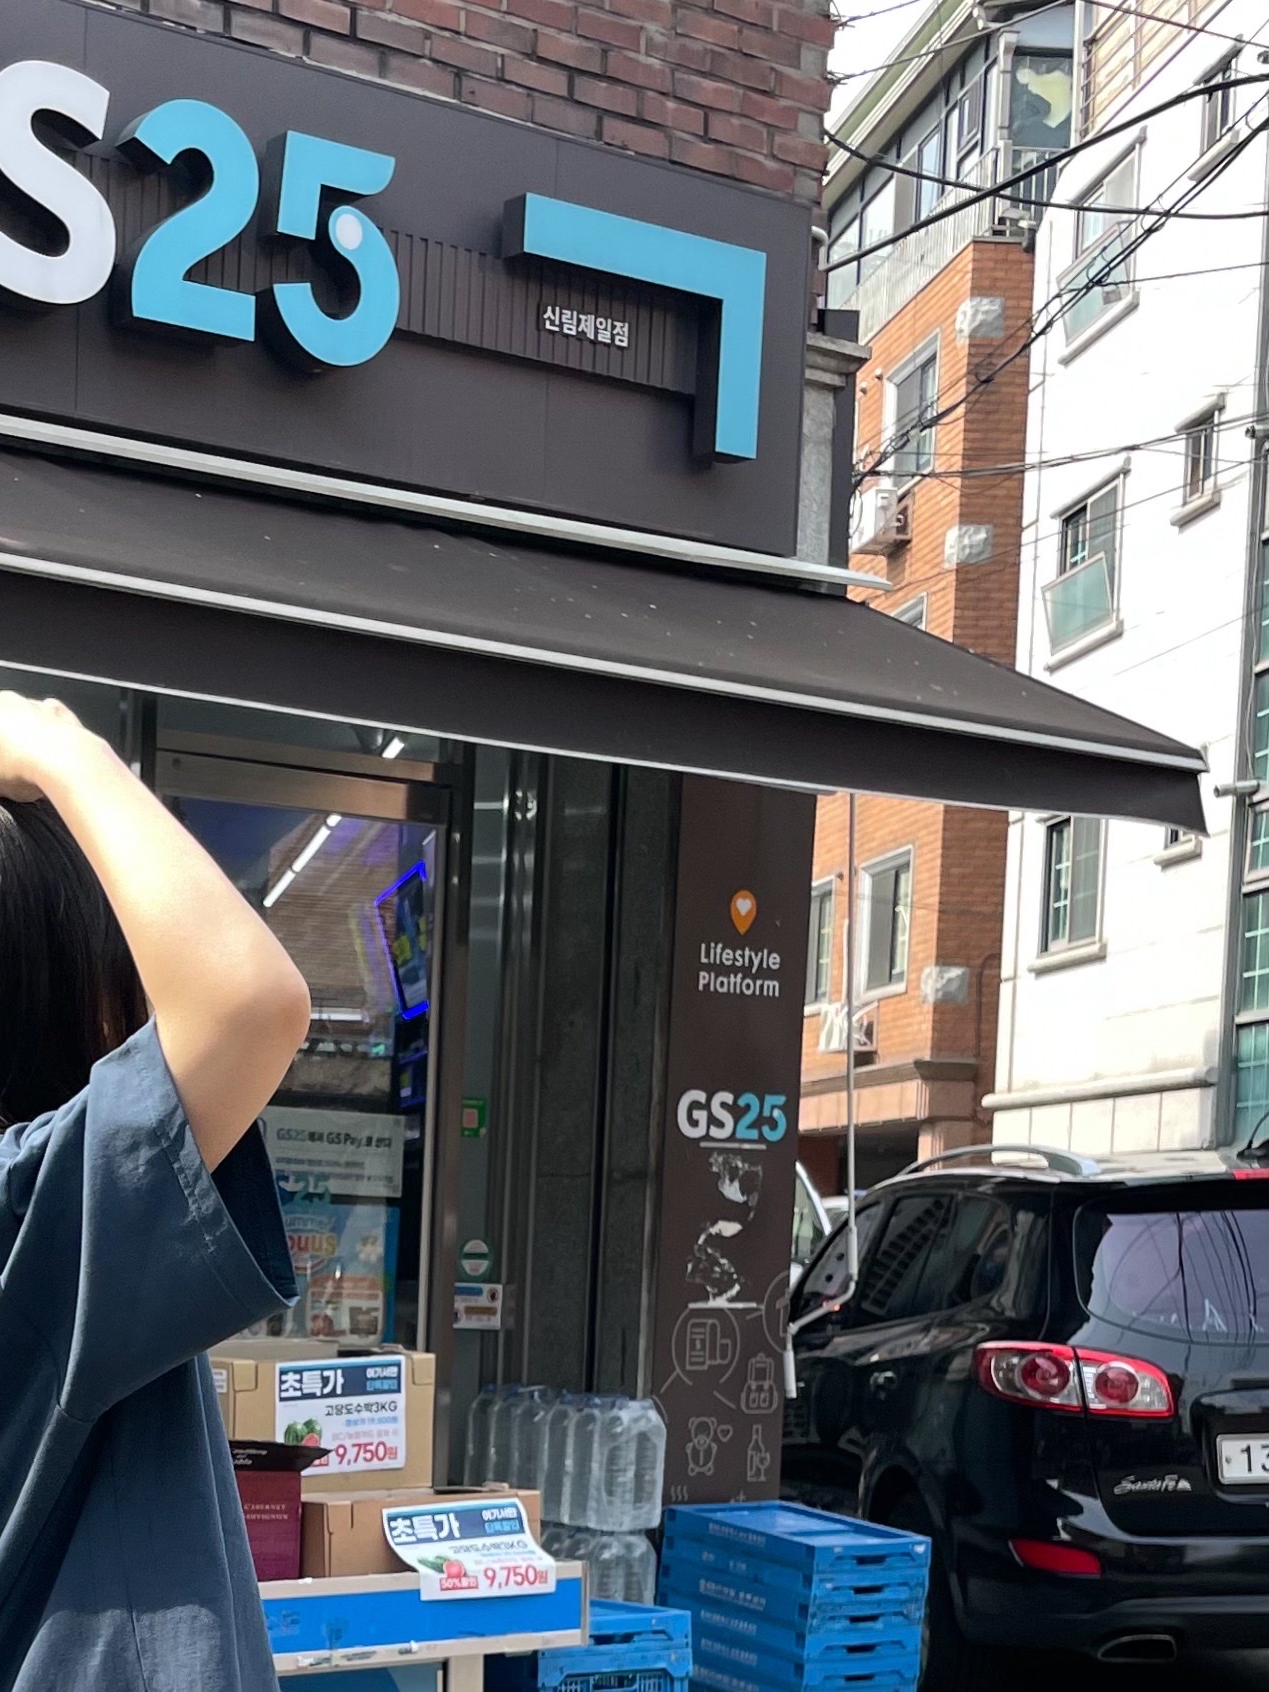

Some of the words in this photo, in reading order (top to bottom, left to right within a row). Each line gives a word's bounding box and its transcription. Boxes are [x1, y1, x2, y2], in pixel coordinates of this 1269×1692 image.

[543, 305, 629, 348] 신림제일점
[700, 943, 781, 974] Lifestyle
[698, 971, 780, 998] Platform
[677, 1089, 787, 1142] GS25
[280, 1368, 344, 1398] 초특가
[334, 1440, 398, 1466] 9,750원
[389, 1512, 460, 1543] 초특가
[484, 1564, 548, 1590] 9,750원
